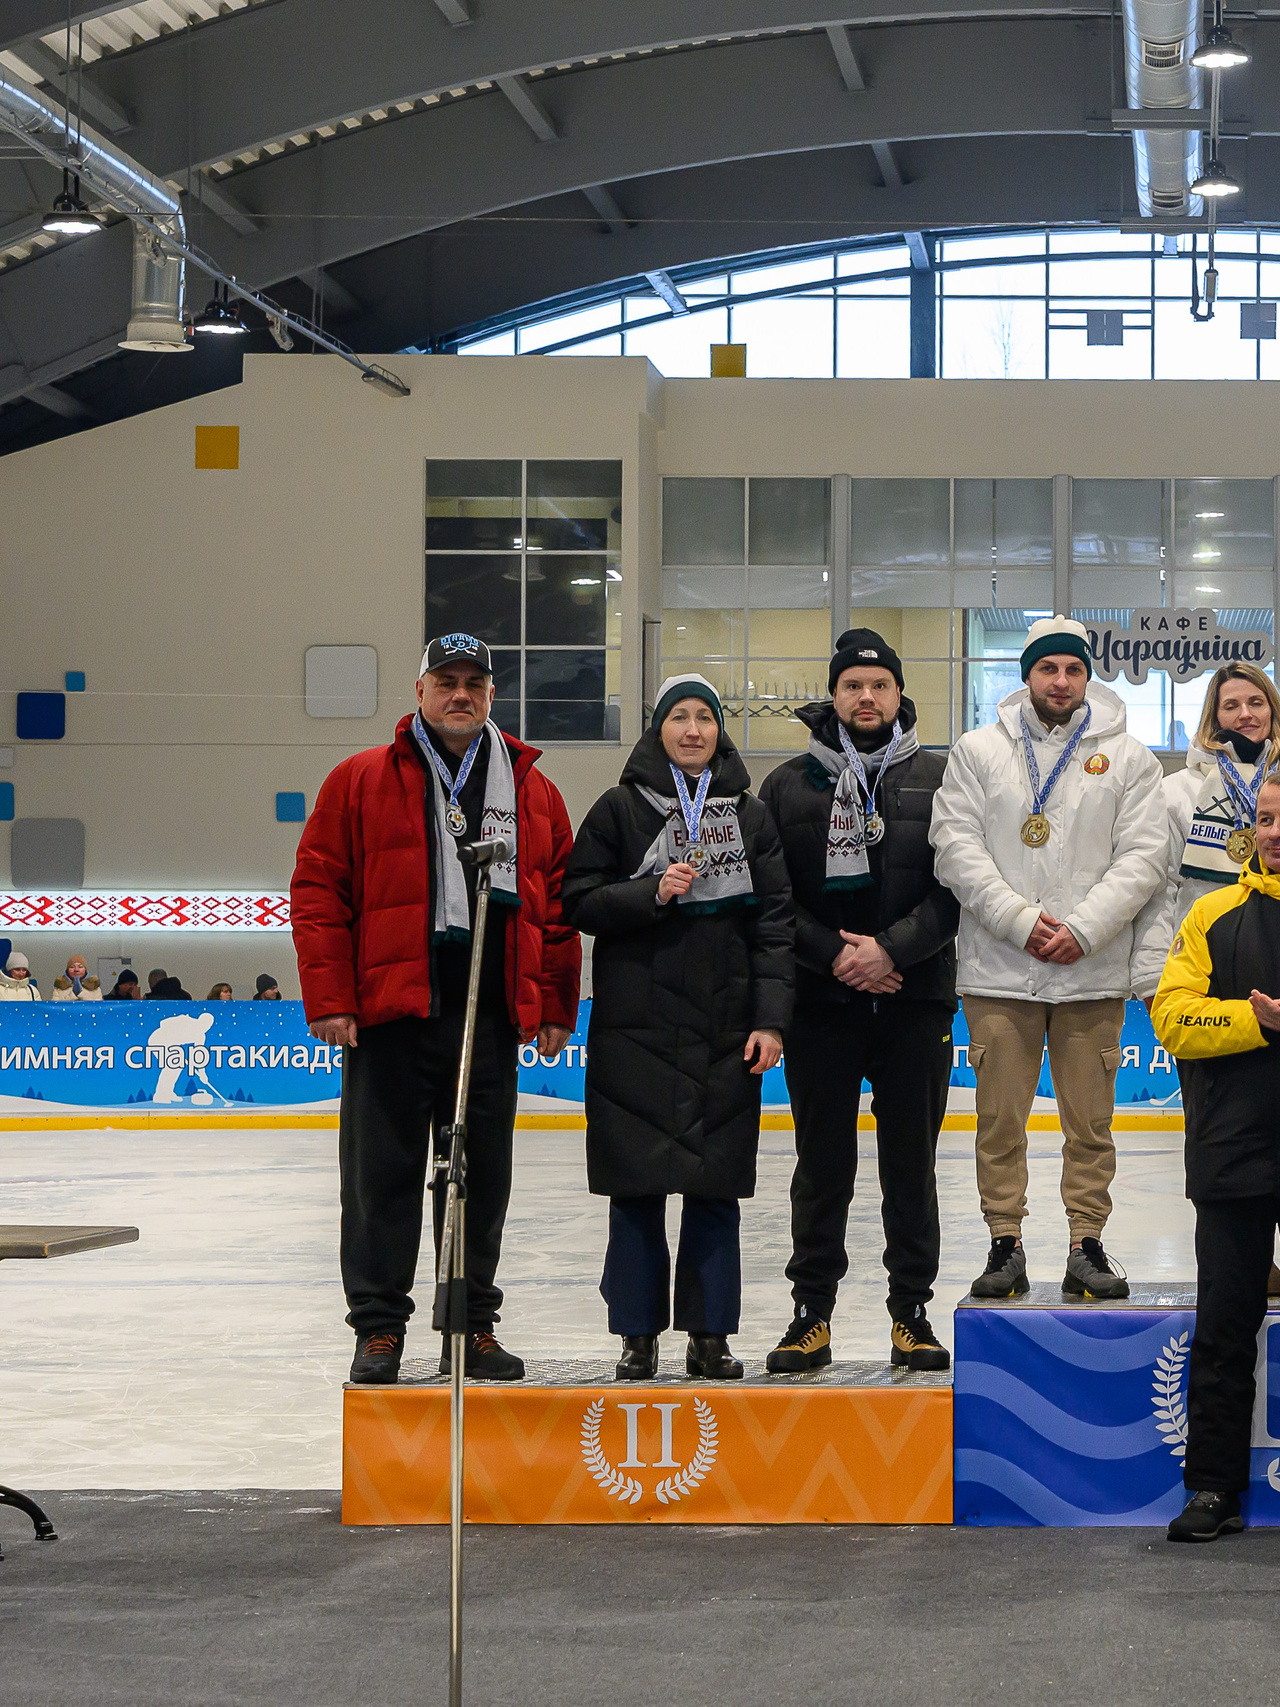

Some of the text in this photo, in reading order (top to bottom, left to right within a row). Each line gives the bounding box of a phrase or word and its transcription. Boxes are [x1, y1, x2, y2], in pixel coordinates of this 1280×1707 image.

[1140, 616, 1208, 631] КАФЕ
[1087, 629, 1266, 677] Чараўніца
[673, 824, 736, 847] ЕИНЫЕ
[1190, 823, 1228, 841] БЕЛЫЕ
[617, 1403, 682, 1469] II
